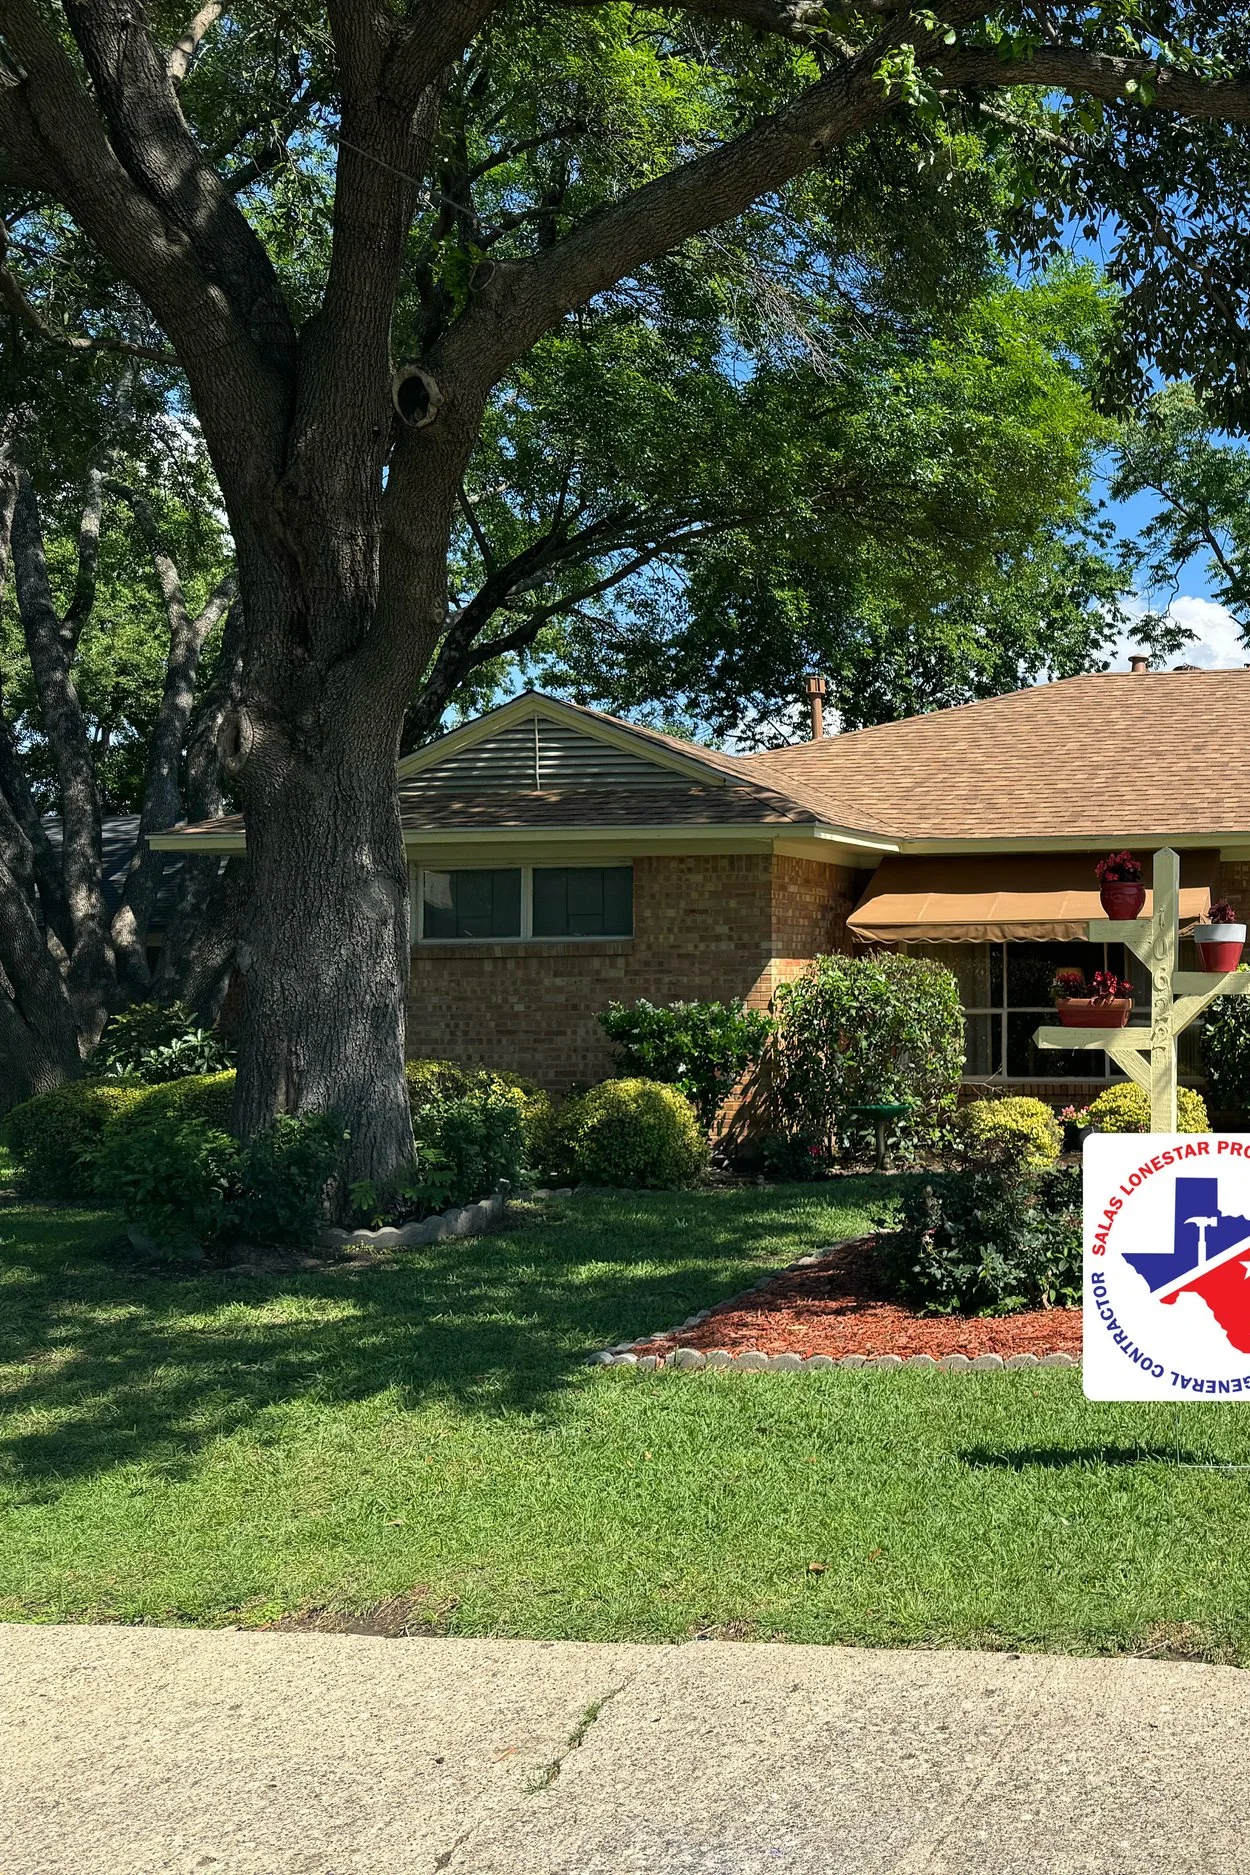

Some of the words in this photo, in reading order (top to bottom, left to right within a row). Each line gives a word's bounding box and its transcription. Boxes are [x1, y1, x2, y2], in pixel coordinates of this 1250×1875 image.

[1091, 1196, 1124, 1257] SALAS
[1119, 1141, 1210, 1197] LONESTAR
[1091, 1271, 1165, 1379] CONTRACTOR
